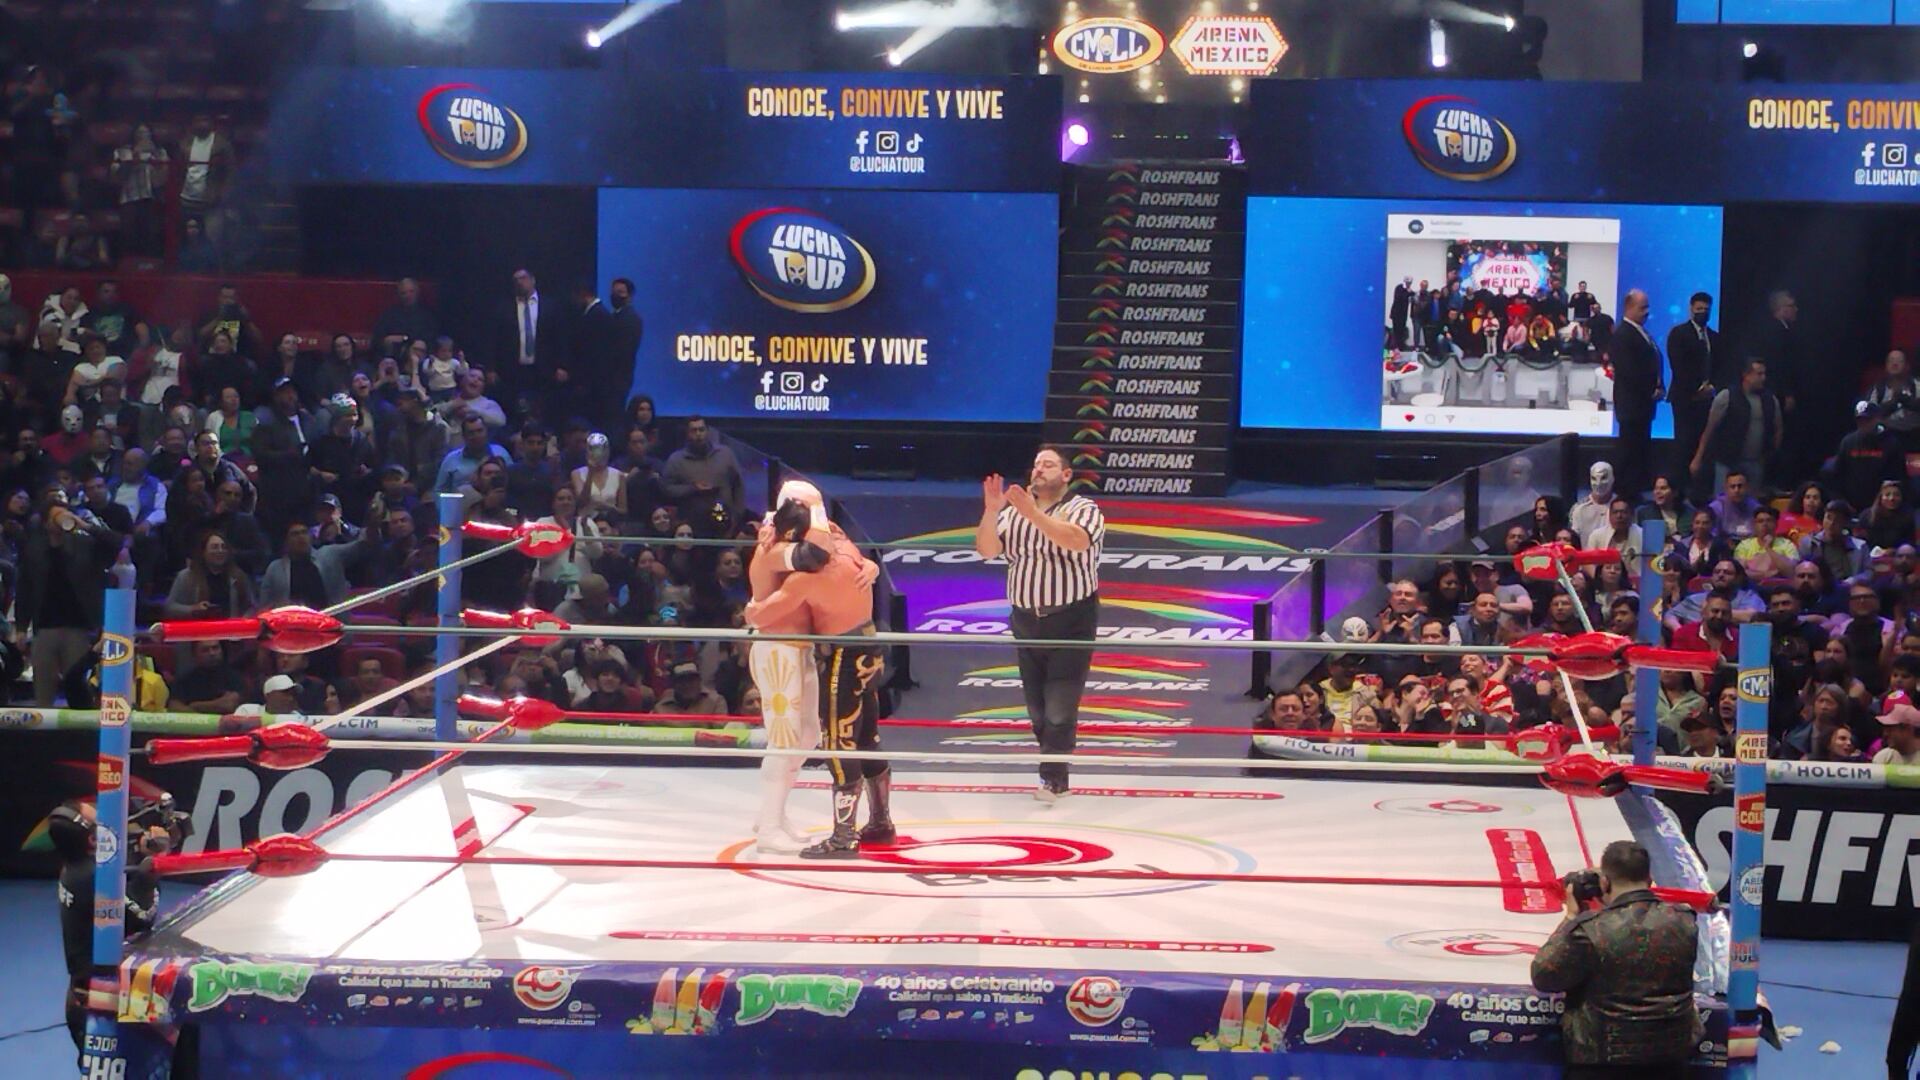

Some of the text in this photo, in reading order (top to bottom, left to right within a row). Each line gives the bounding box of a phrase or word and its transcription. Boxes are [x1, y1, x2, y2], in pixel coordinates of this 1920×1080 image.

[1194, 27, 1266, 43] ARENA
[1191, 46, 1269, 63] MEXICO
[450, 98, 506, 127] LUCHA
[748, 87, 1004, 121] CONOCE, CONVIVE Y VIVE
[1436, 109, 1494, 139] LUCHA
[1748, 99, 1841, 133] CONOCE,
[849, 156, 926, 174] @LUCHATOUR
[1140, 170, 1220, 185] ROSHFRANS
[1854, 168, 1920, 186] @LUCHATO
[1139, 191, 1220, 207] ROSHFRANS
[1135, 214, 1217, 230] ROSHFRANS
[772, 224, 847, 261] LUCHA
[1130, 236, 1213, 252] ROSHFRANS
[1128, 259, 1211, 275] ROSHFRANS
[1125, 282, 1209, 298] ROSHFRANS
[1122, 306, 1207, 322] ROSHFRANS
[1120, 330, 1205, 346] ROSHFRANS
[676, 334, 928, 366] CONOCE, CONVIVE Y VIVE
[1117, 354, 1203, 370] ROSHFRANS
[1115, 378, 1202, 395] ROSHFRANS
[754, 394, 830, 412] @LUCHATOUR
[1112, 403, 1199, 419] ROSHFRANS
[1109, 427, 1197, 444] ROSHFRANS
[1106, 452, 1194, 469] ROSHFRANS
[1103, 477, 1192, 494] ROSHFRANS
[1797, 765, 1872, 780] HOLCIM
[338, 975, 380, 987] Calidad
[381, 977, 402, 989] que
[874, 974, 1056, 993] 40 años Celebrando
[888, 990, 931, 1002] Calidad
[932, 993, 954, 1003] que
[955, 991, 982, 1003] sabe
[983, 994, 991, 1003] a
[1446, 992, 1474, 1009] 40
[1477, 993, 1522, 1011] años
[1461, 1010, 1505, 1023] Calidad
[1506, 1014, 1528, 1025] que
